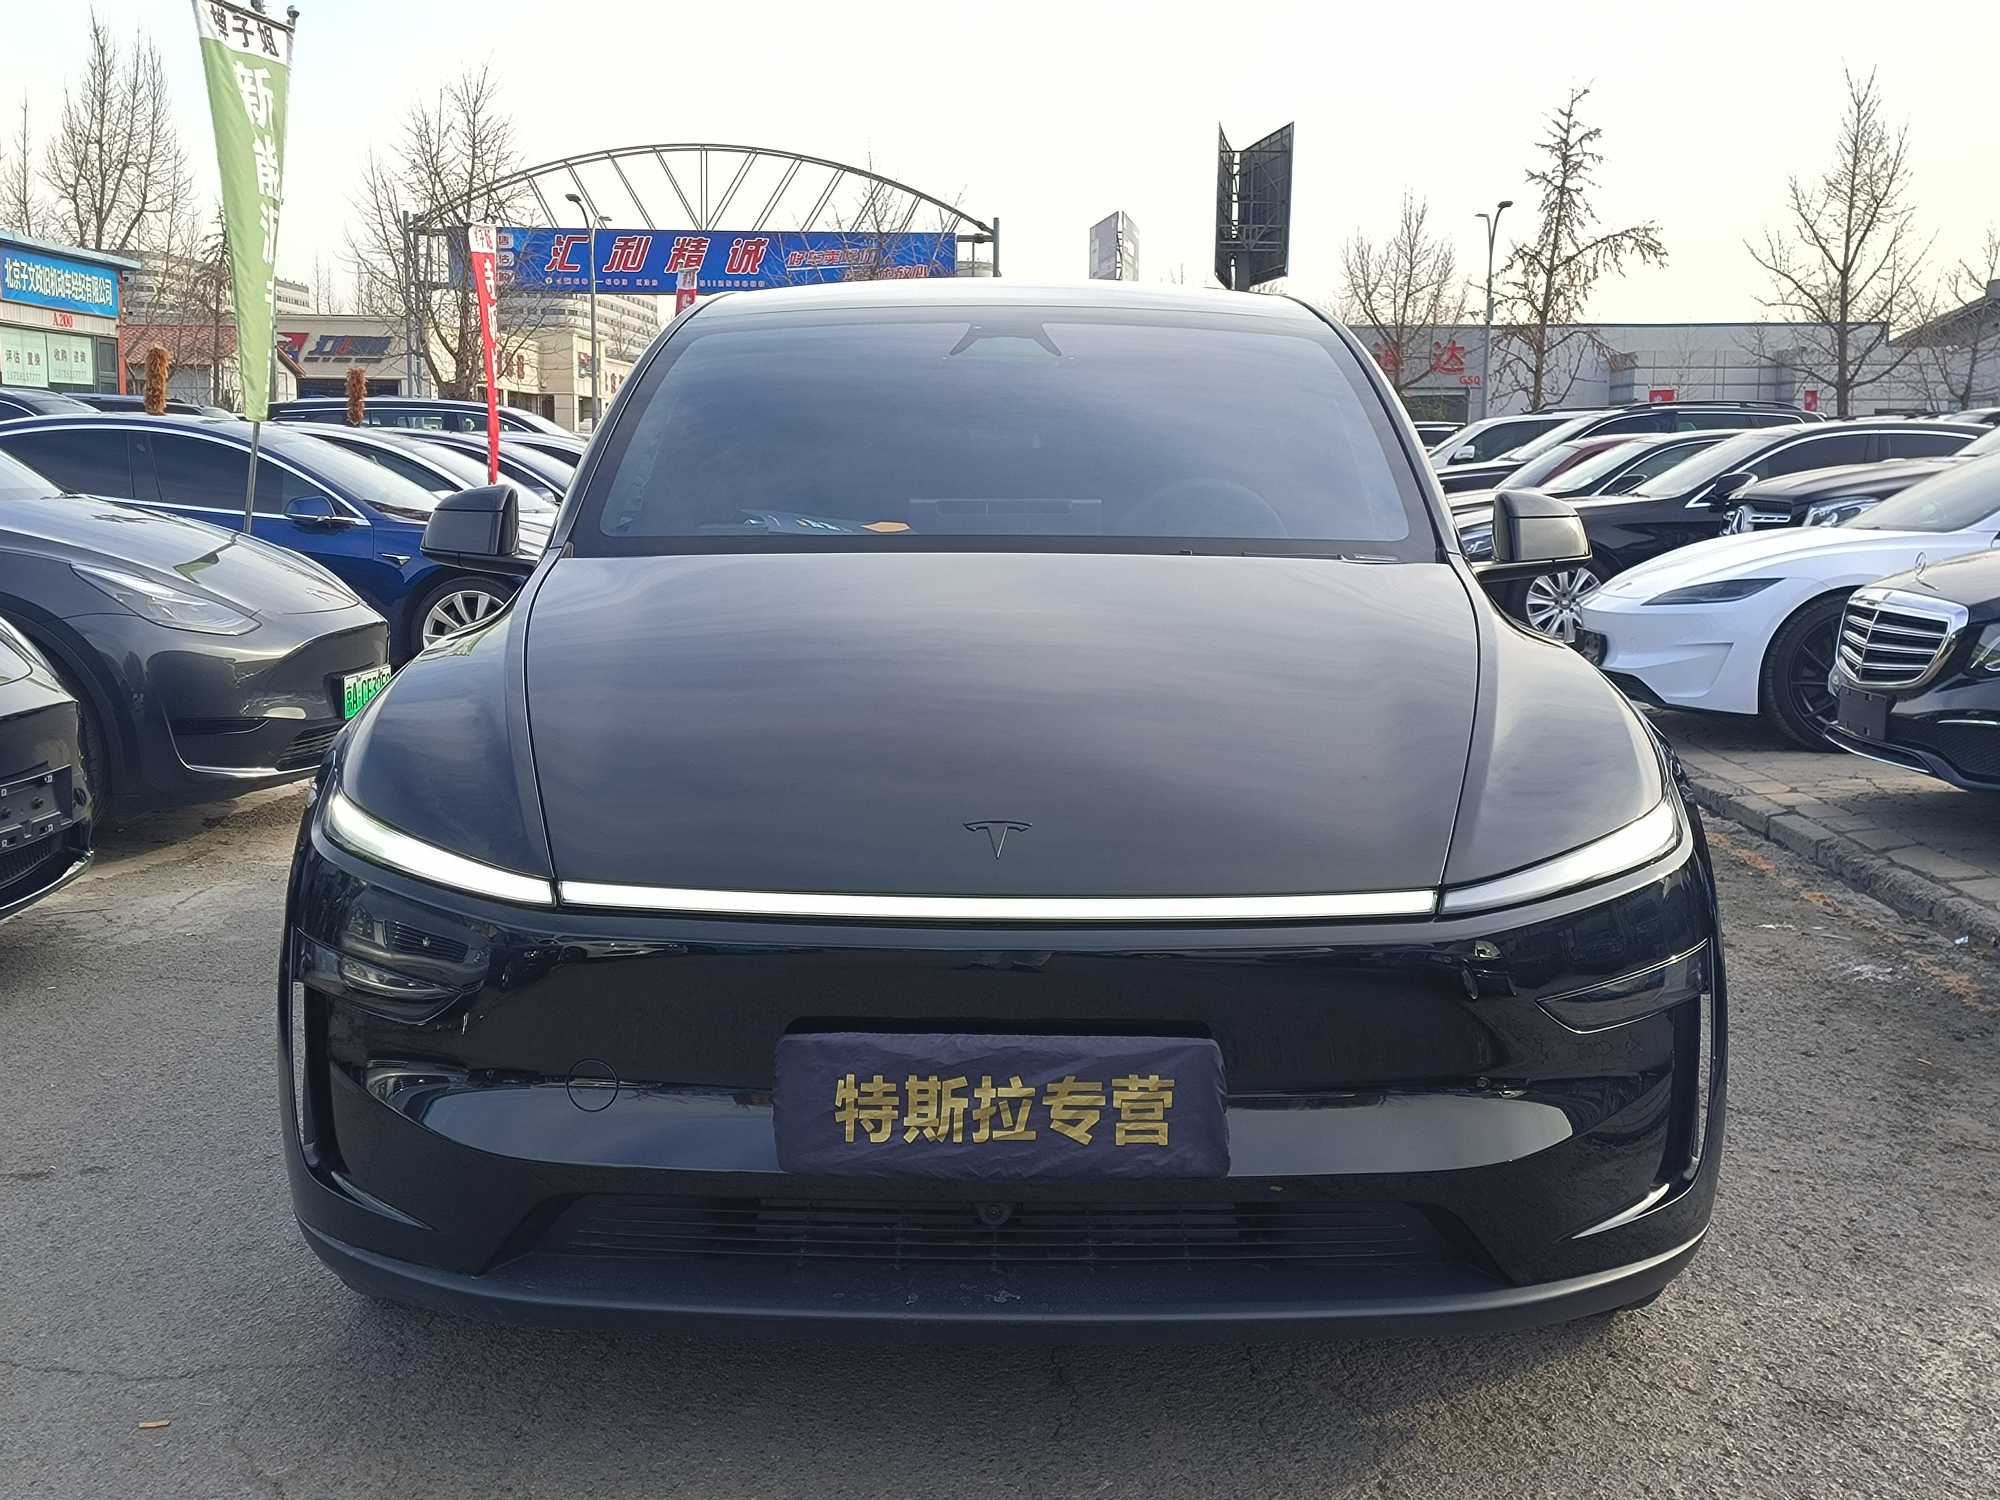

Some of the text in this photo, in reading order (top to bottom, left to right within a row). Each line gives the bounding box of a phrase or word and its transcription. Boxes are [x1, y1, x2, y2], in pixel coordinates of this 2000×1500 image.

[545, 234, 769, 275] 汇利精诚
[834, 1073, 1176, 1146] 特斯拉专营
